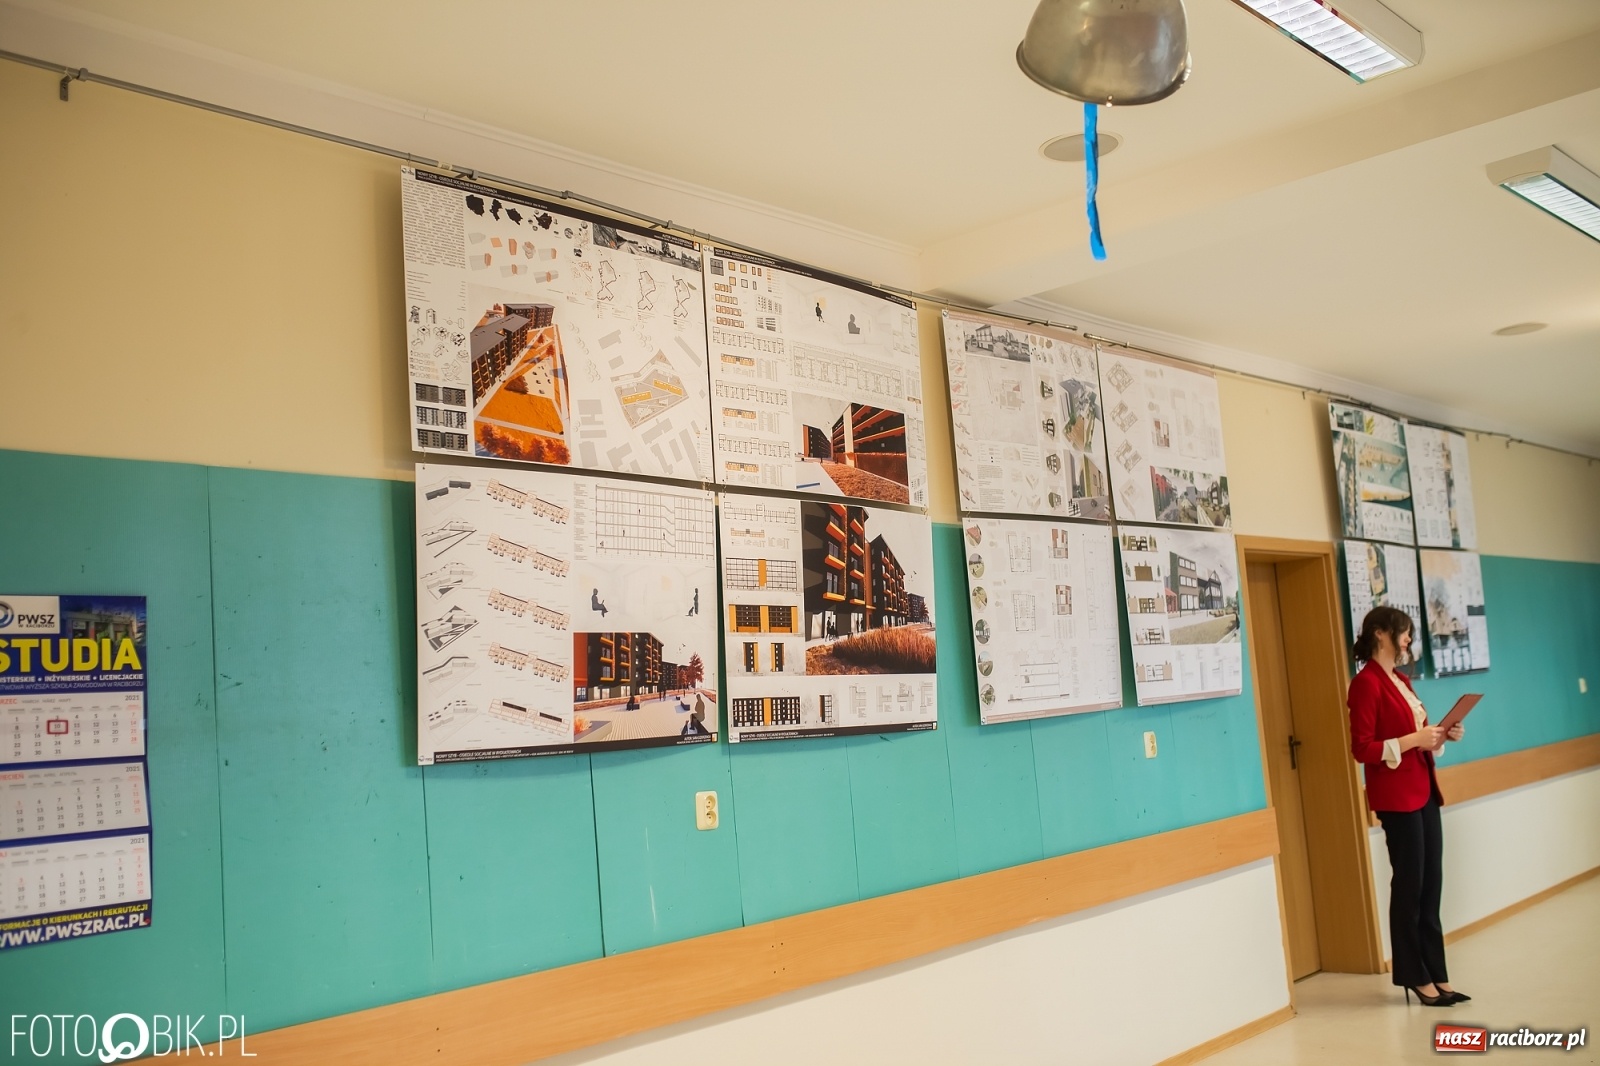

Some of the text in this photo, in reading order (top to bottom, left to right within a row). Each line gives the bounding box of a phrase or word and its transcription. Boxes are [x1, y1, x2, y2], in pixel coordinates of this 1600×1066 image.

[18, 615, 54, 624] PWSZ
[44, 674, 90, 682] INŻYNIERSKIE
[50, 912, 98, 924] KIERUNKACH
[103, 904, 148, 916] REKRUTACJI
